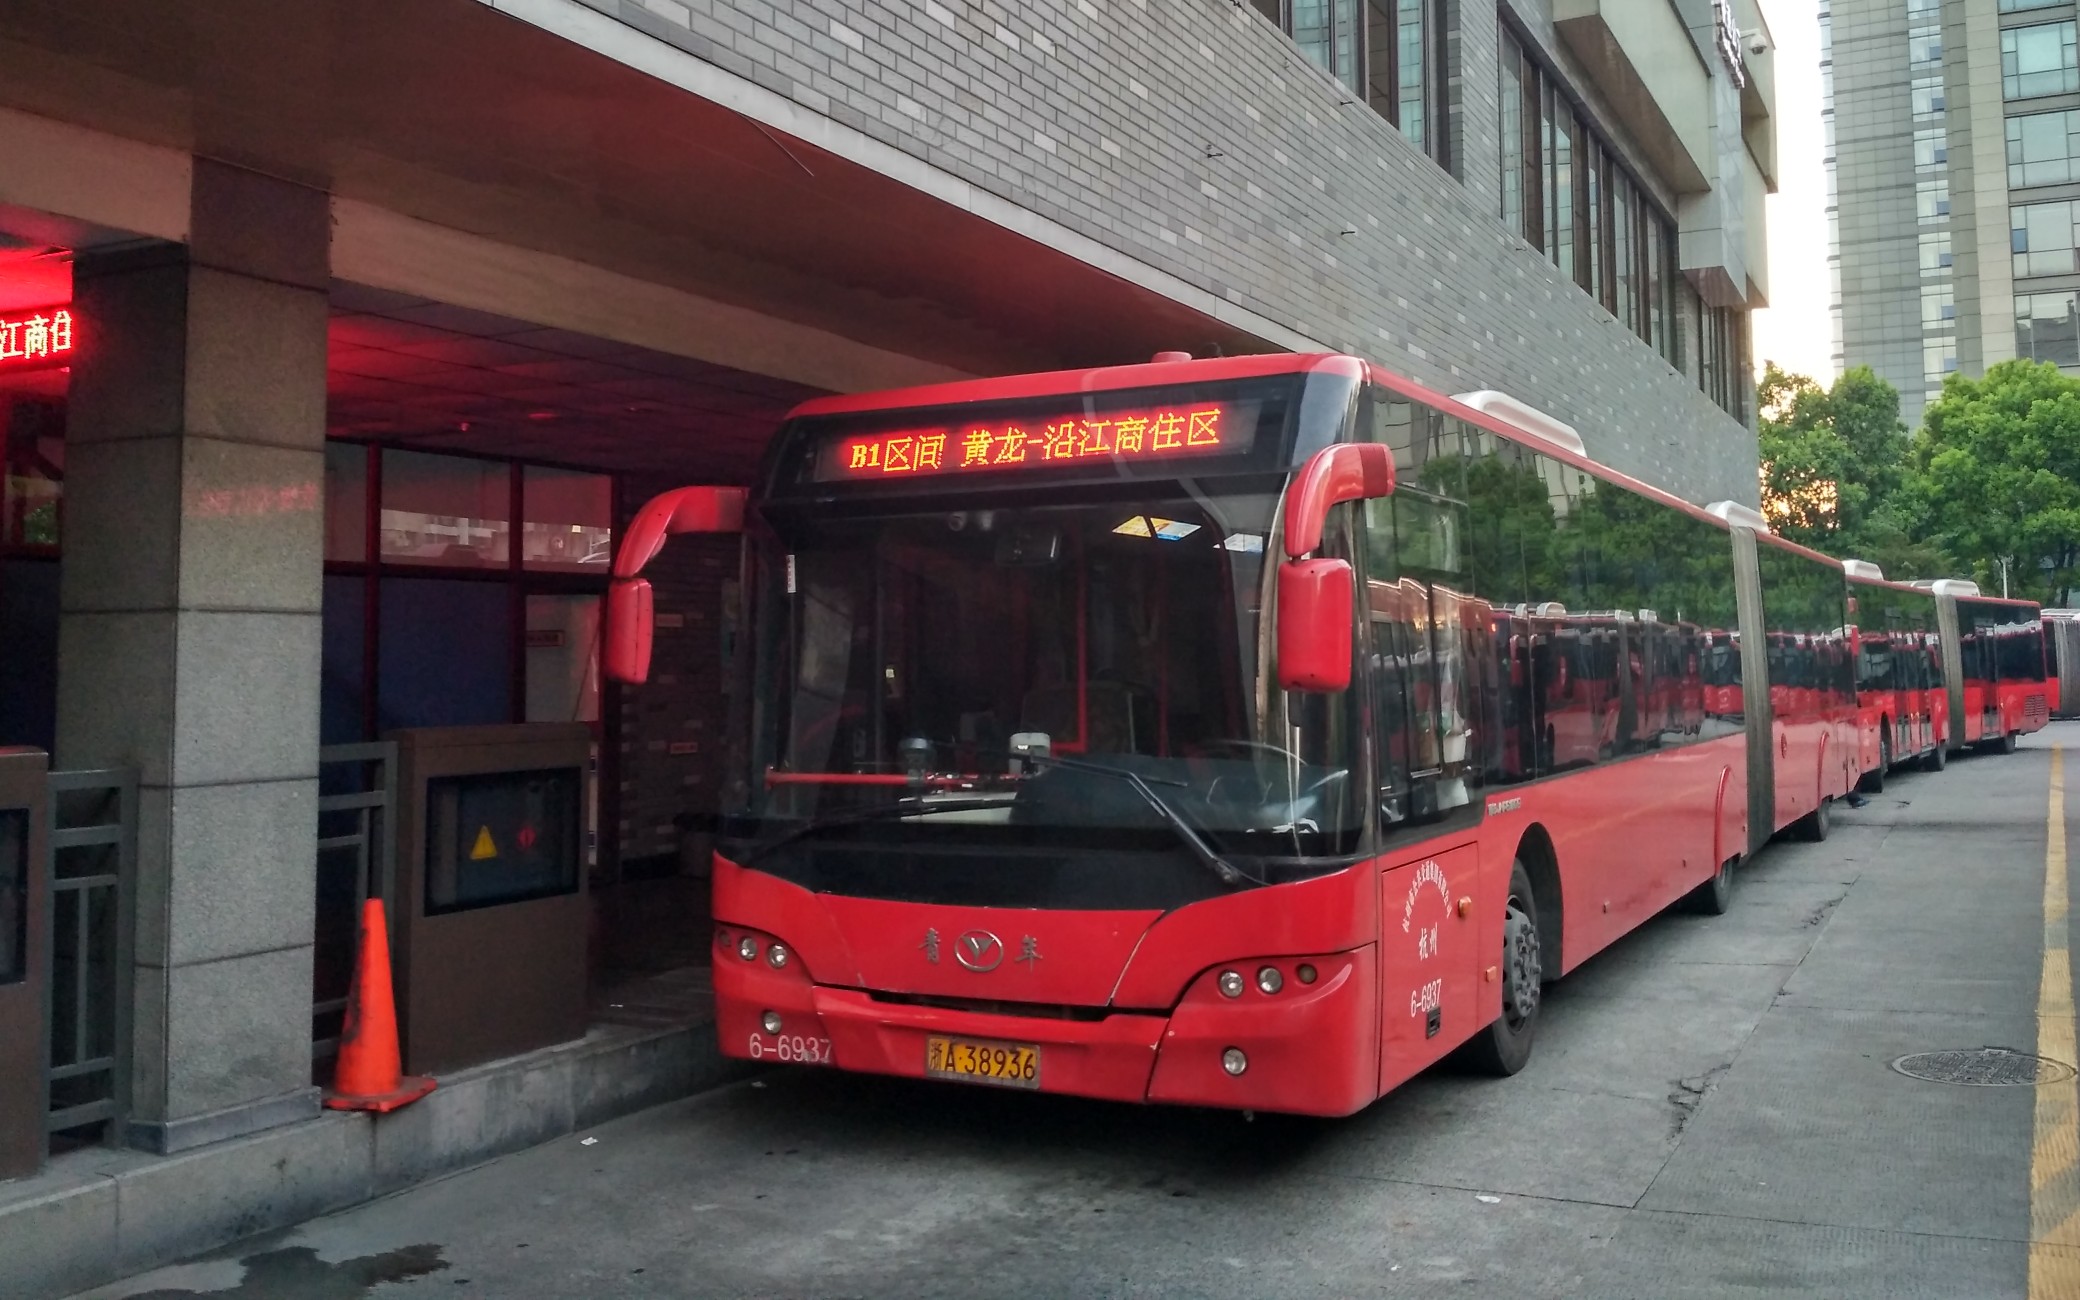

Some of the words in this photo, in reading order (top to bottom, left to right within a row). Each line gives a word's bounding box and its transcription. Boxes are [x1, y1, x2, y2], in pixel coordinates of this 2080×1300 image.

[849, 432, 947, 473] B1区间
[1418, 921, 1439, 961] 杭州
[1410, 977, 1442, 1018] 6-6937
[749, 1032, 832, 1063] 6-6937
